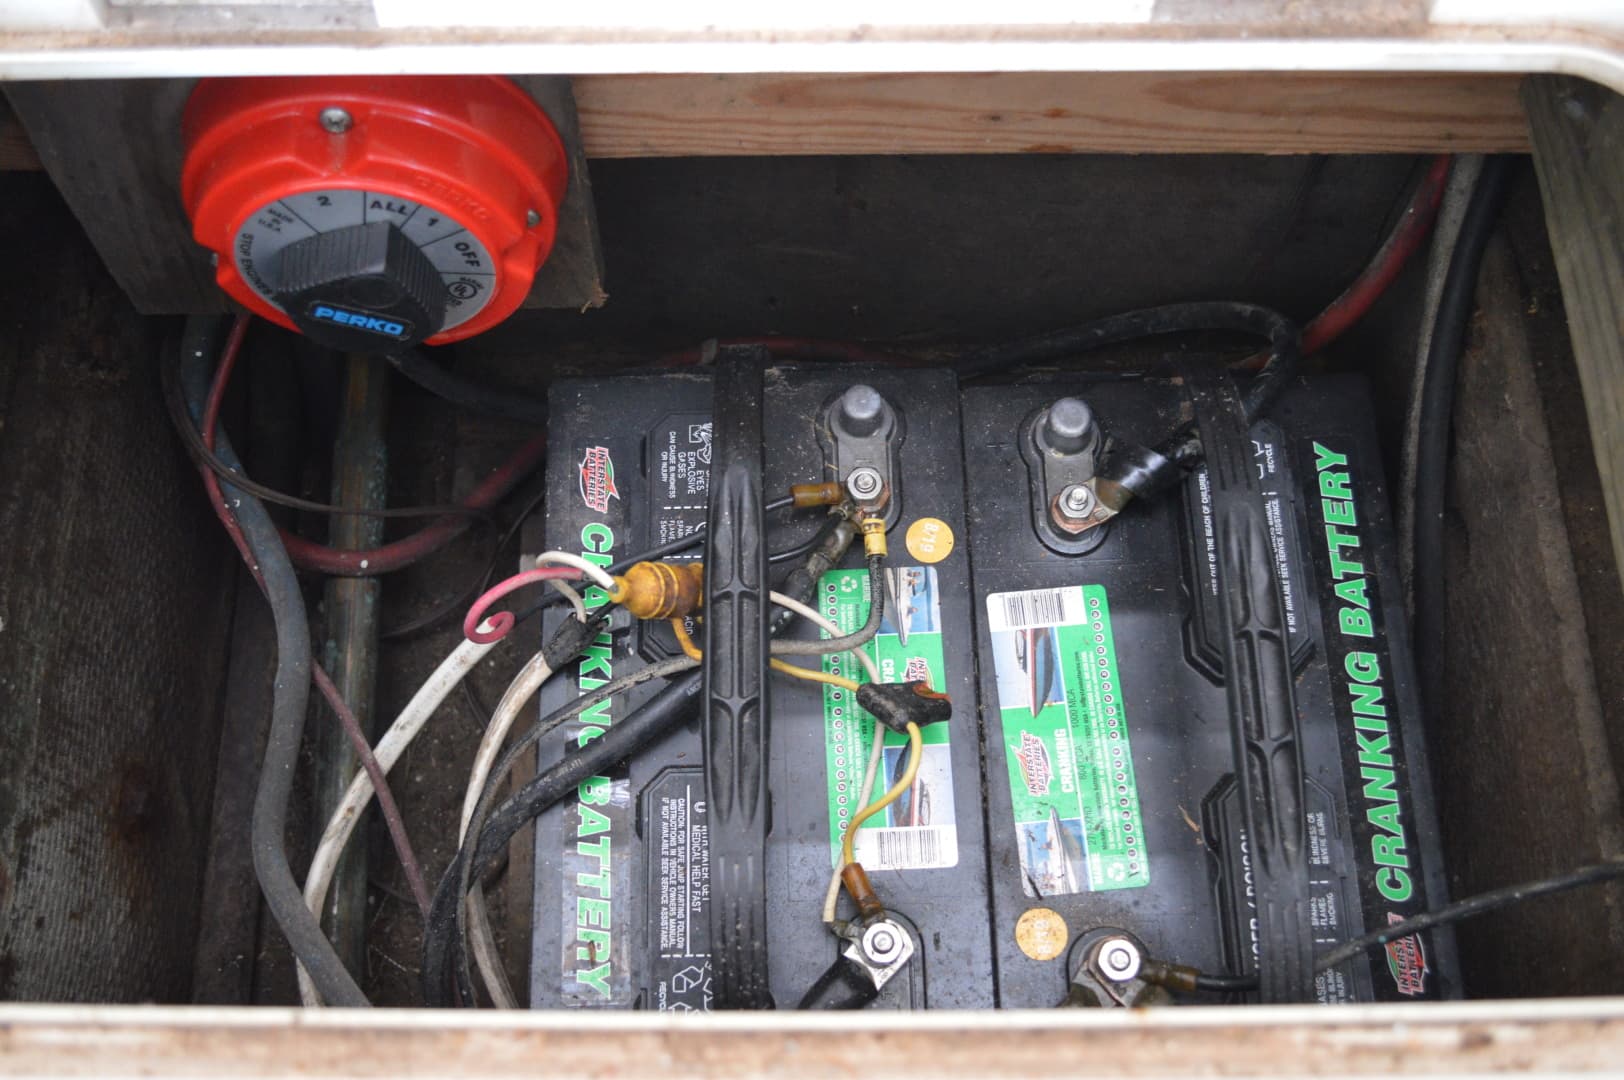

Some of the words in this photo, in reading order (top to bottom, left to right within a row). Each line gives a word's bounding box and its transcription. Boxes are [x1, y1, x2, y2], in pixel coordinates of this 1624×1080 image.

[317, 195, 332, 206] 2
[370, 200, 408, 216] ALL
[428, 217, 439, 227] 1
[240, 233, 254, 257] STOP
[454, 242, 481, 267] OFF
[315, 305, 405, 336] PERKO
[669, 431, 677, 443] CAN
[669, 445, 677, 464] CAUSE
[677, 451, 687, 479] GASES
[587, 451, 597, 506] BATTERIES
[597, 449, 607, 510] INTERSTATE
[687, 451, 696, 495] EXPLOSIVE
[696, 470, 705, 491] EYES
[1202, 505, 1210, 514] OF
[1207, 538, 1215, 551] THE
[1313, 441, 1374, 637] BATTERY
[1208, 553, 1216, 562] OF
[1287, 612, 1296, 625] NOT
[1022, 735, 1038, 794] INTERSTATE
[1031, 739, 1046, 792] BATTERIES
[1053, 728, 1075, 793] CRANKING
[1345, 651, 1413, 902] CRANKING
[661, 806, 669, 819] NOT
[661, 821, 669, 856] AVAILABLE
[677, 831, 685, 844] FOR
[692, 825, 702, 862] MEDICAL
[661, 858, 669, 875] SEEK
[677, 846, 685, 863] SAFE
[669, 858, 677, 885] VEHICLE
[677, 865, 685, 883] JUMP
[692, 865, 702, 888] HELP
[577, 776, 611, 1000] BATTERY
[661, 877, 669, 905] SERVICE
[677, 885, 685, 918] STARTING
[692, 890, 702, 913] FAST
[676, 921, 685, 949] FOLLOW
[1405, 936, 1419, 987] BATTERI
[1315, 976, 1327, 1004] ASES
